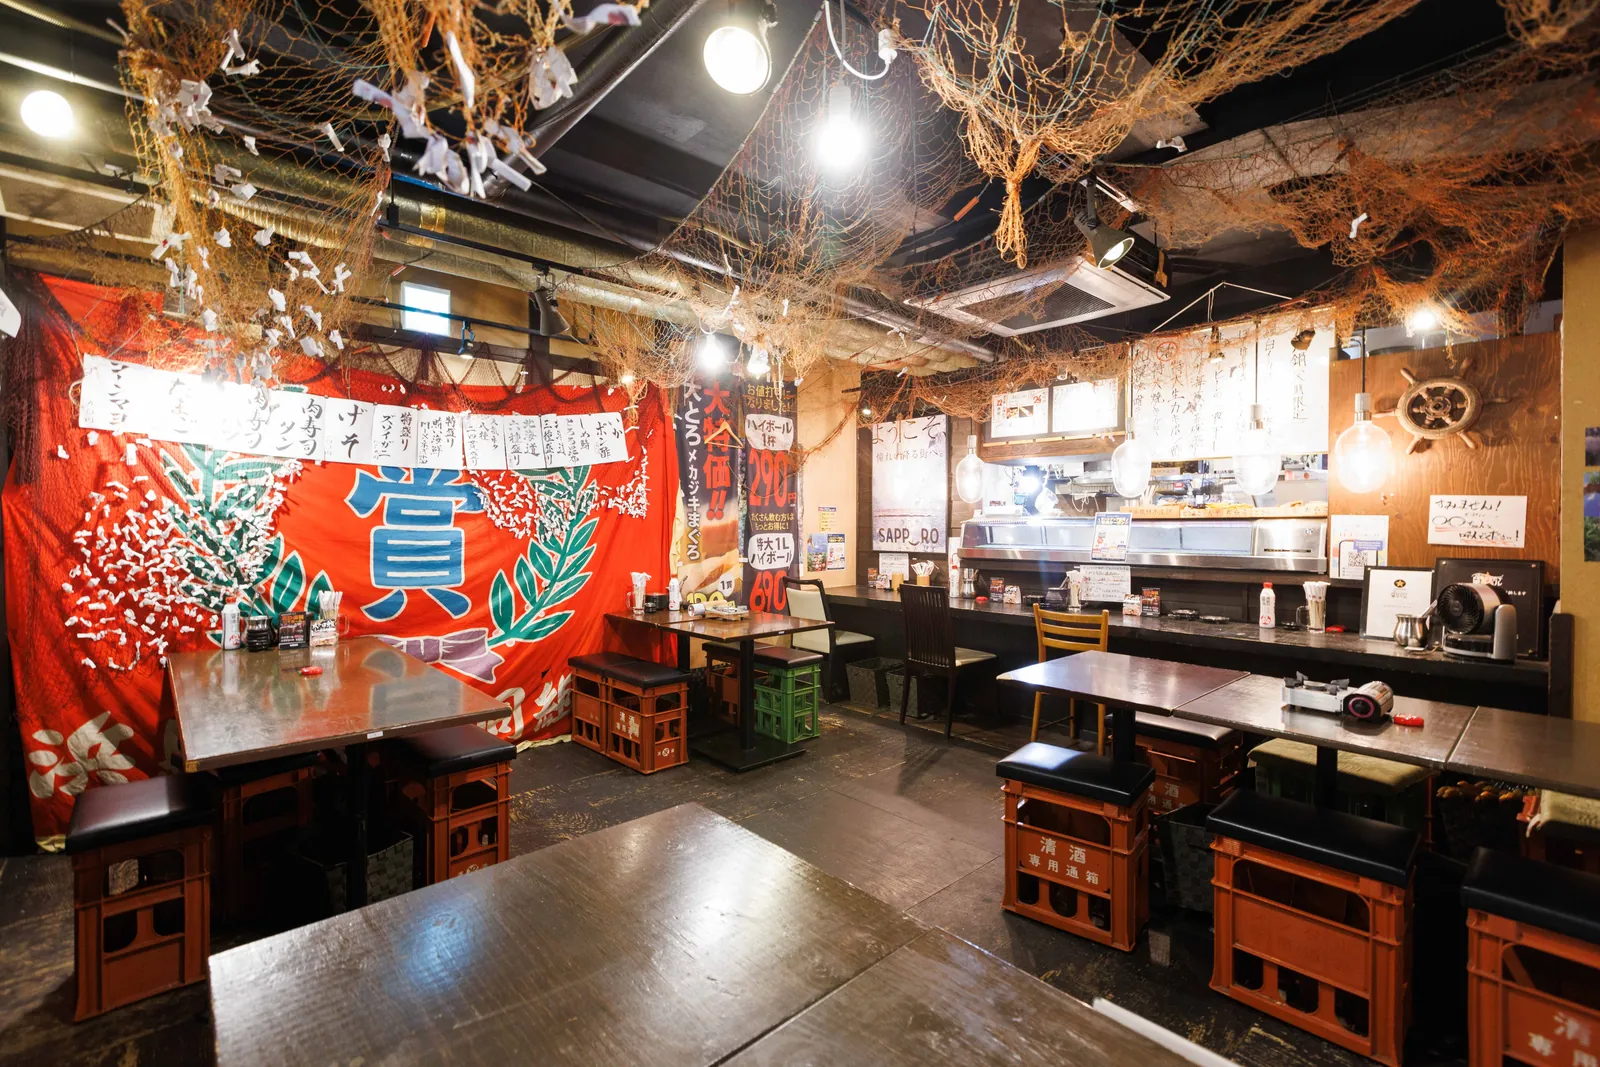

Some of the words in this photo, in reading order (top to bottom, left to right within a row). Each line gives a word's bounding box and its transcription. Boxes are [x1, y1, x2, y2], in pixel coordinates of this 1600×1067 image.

[276, 420, 296, 452] タン
[300, 398, 322, 456] 肉寿司
[339, 404, 367, 459] げそ
[400, 411, 412, 451] 特盛り
[445, 415, 457, 448] 特盛り
[523, 418, 540, 457] 北海道
[544, 419, 554, 465] 三種盛り
[748, 419, 792, 434] ハイボール
[761, 433, 776, 447] 1杯
[749, 447, 788, 507] 290
[750, 512, 794, 521] たくさん飲む方は
[345, 467, 488, 622] 賞
[751, 550, 792, 566] ハイボール
[749, 570, 787, 614] 690
[1040, 836, 1087, 865] 清酒
[1028, 853, 1099, 885] 専用通箱
